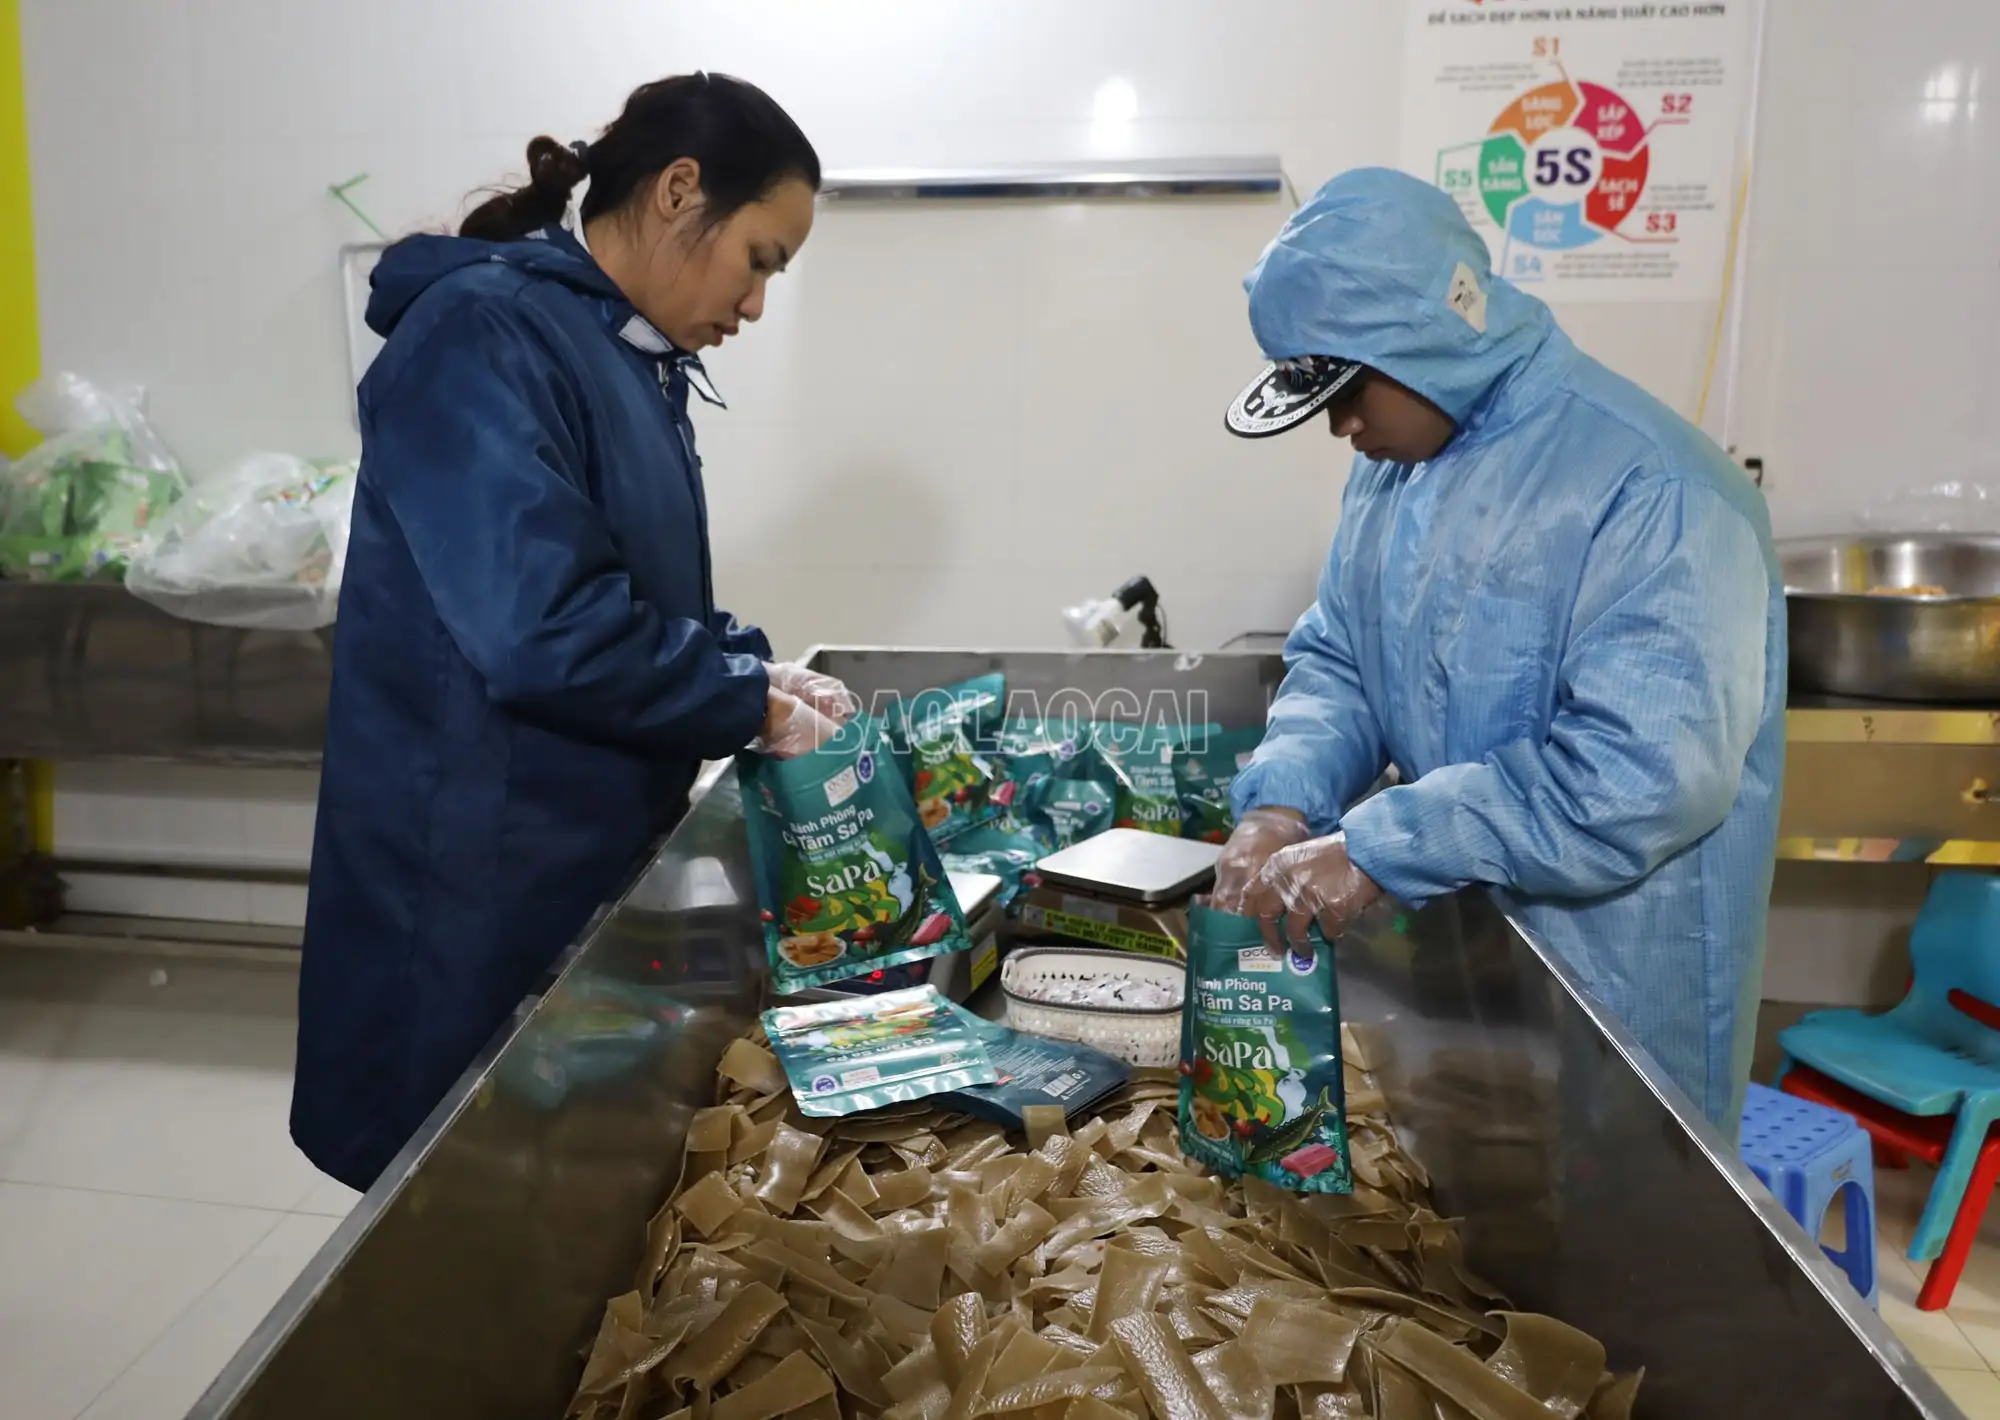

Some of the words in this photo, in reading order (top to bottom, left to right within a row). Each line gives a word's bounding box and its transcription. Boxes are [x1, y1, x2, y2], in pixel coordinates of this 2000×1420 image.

[1660, 5, 1689, 18] CAO
[1532, 37, 1560, 57] S1
[1661, 93, 1693, 115] S2
[1535, 147, 1593, 186] 5S
[1444, 170, 1474, 189] S5
[1646, 213, 1678, 234] S3
[1513, 254, 1542, 275] S4
[837, 822, 859, 841] Sa
[857, 807, 876, 828] Pa
[806, 859, 882, 899] SaPa
[1242, 947, 1271, 958] OCO
[1225, 977, 1267, 993] Phồng
[1238, 994, 1263, 1011] Sa
[1267, 995, 1293, 1011] Pa
[1203, 1035, 1275, 1070] SaPa
